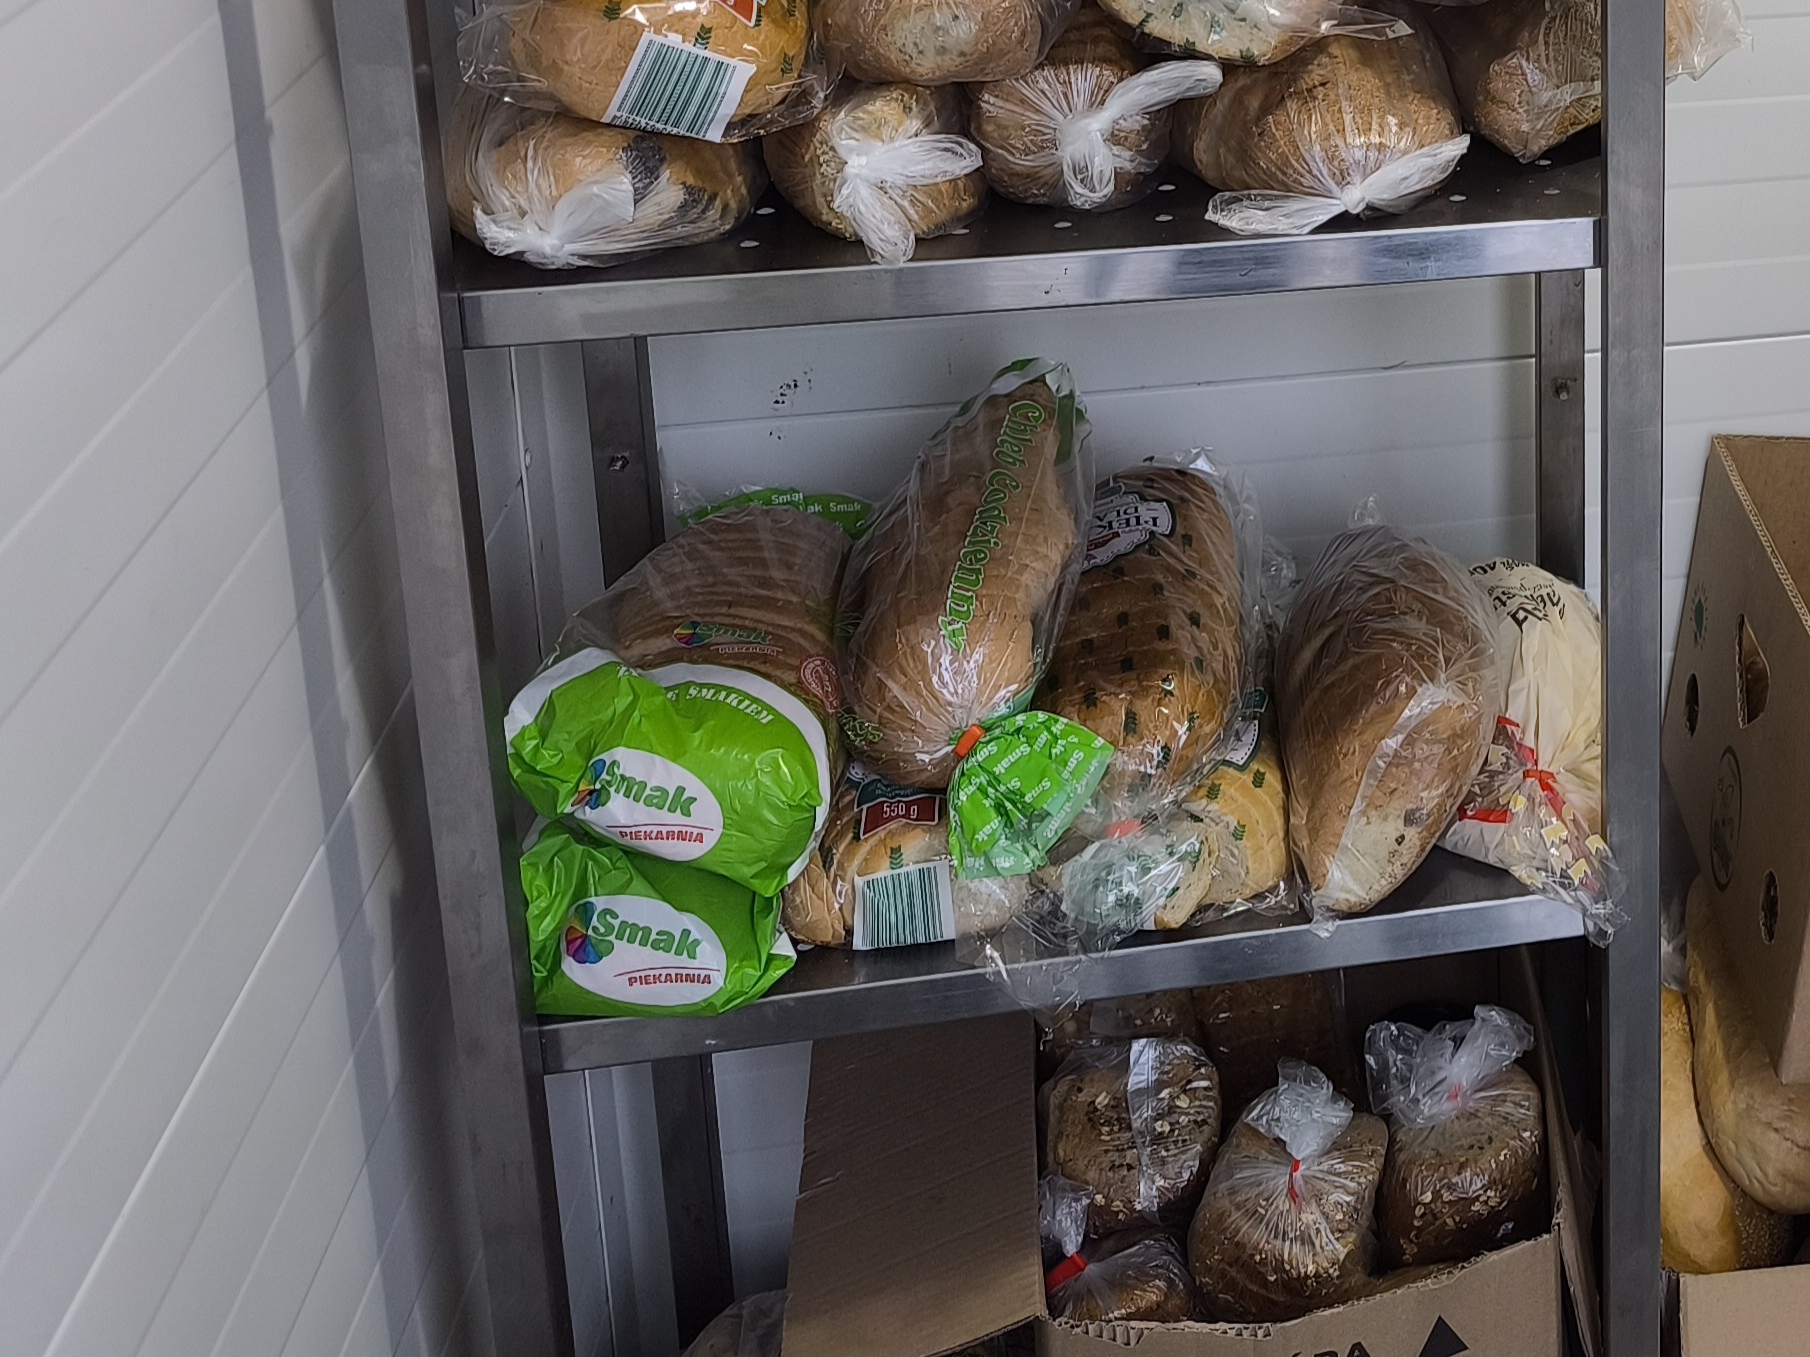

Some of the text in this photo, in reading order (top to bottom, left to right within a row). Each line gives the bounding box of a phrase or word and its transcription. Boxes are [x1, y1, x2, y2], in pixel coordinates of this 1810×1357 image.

[771, 491, 804, 505] Sma
[829, 502, 862, 512] Smak
[938, 400, 1045, 655] Chleb Codzienny
[695, 622, 773, 645] Smak
[686, 685, 775, 724] SMAKIEM
[993, 743, 1031, 776] Smak
[1061, 749, 1085, 780] Sma
[599, 759, 698, 818] Smak
[1024, 777, 1051, 804] Sma
[882, 802, 918, 819] 550 g
[618, 830, 704, 844] PIEKARNIA
[591, 907, 703, 960] Smak
[627, 972, 712, 987] PIEKARNIA
